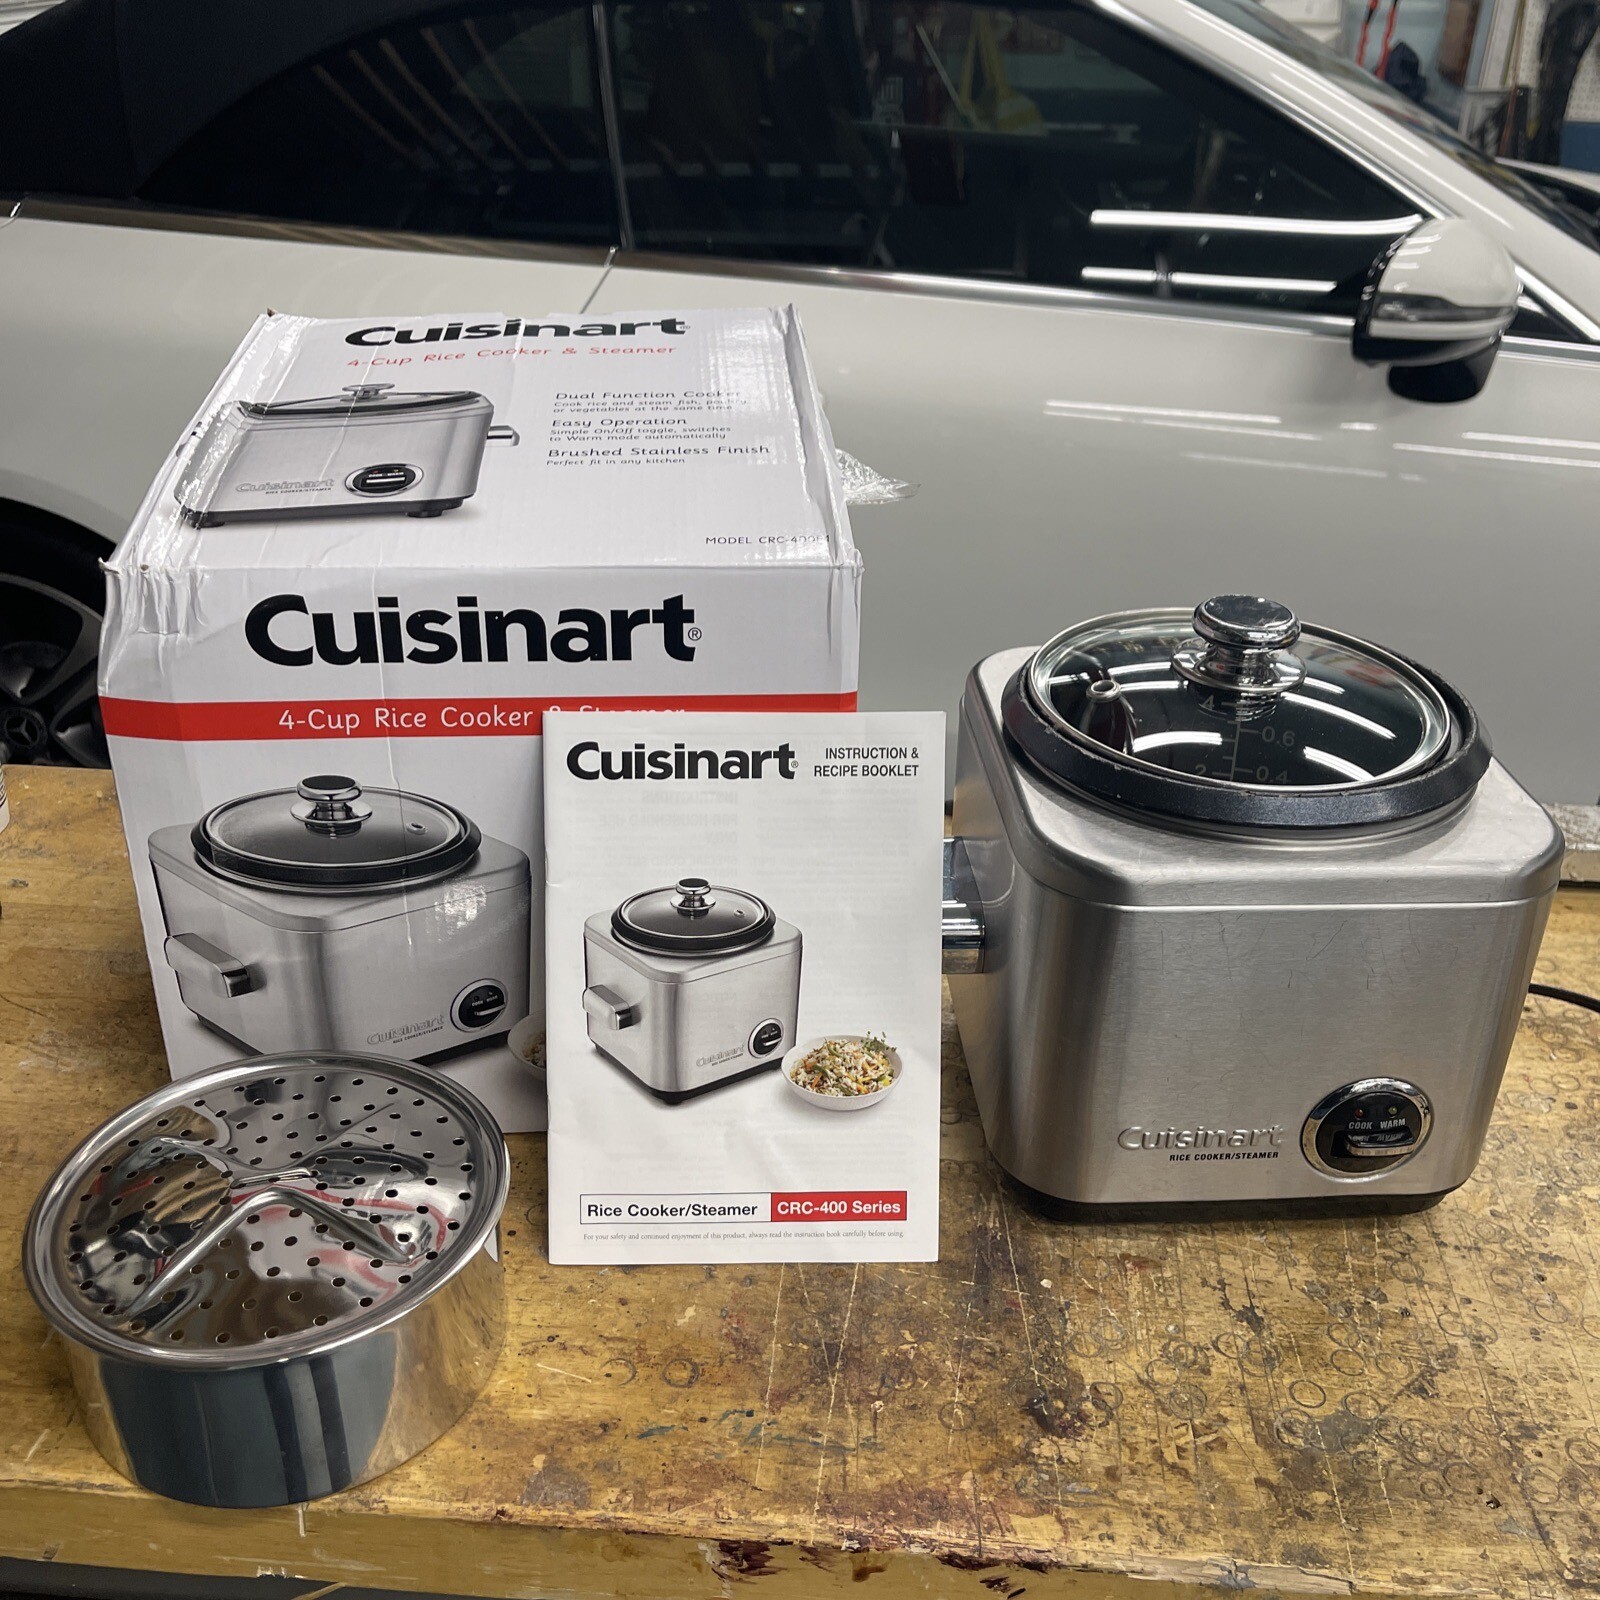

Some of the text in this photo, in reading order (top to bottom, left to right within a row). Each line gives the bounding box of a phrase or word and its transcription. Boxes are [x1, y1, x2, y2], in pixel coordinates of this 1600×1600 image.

[347, 346, 677, 367] 4-Cup Rice Cooker & Steamer
[556, 392, 595, 400] Dual
[603, 391, 676, 399] Function
[570, 406, 629, 414] vegetables
[552, 418, 687, 428] Easy Operation
[548, 445, 770, 457] Brushed Stainless Finish
[278, 705, 533, 734] 4-Cup Rice Cooker
[825, 748, 908, 759] INSTRUCTION
[911, 748, 919, 759] &
[814, 765, 919, 777] RECIPE BOOKLET
[1348, 1118, 1406, 1130] COOK WARM
[1117, 1124, 1285, 1151] Cuisinart
[1169, 1151, 1279, 1162] RICE COOKER/STEAMER
[587, 1200, 901, 1217] Rice Cooker/Steamer CRC-400 Series
[610, 1233, 626, 1241] safety
[671, 1233, 701, 1241] enjoyment
[749, 1231, 768, 1240] always
[826, 1230, 841, 1238] book
